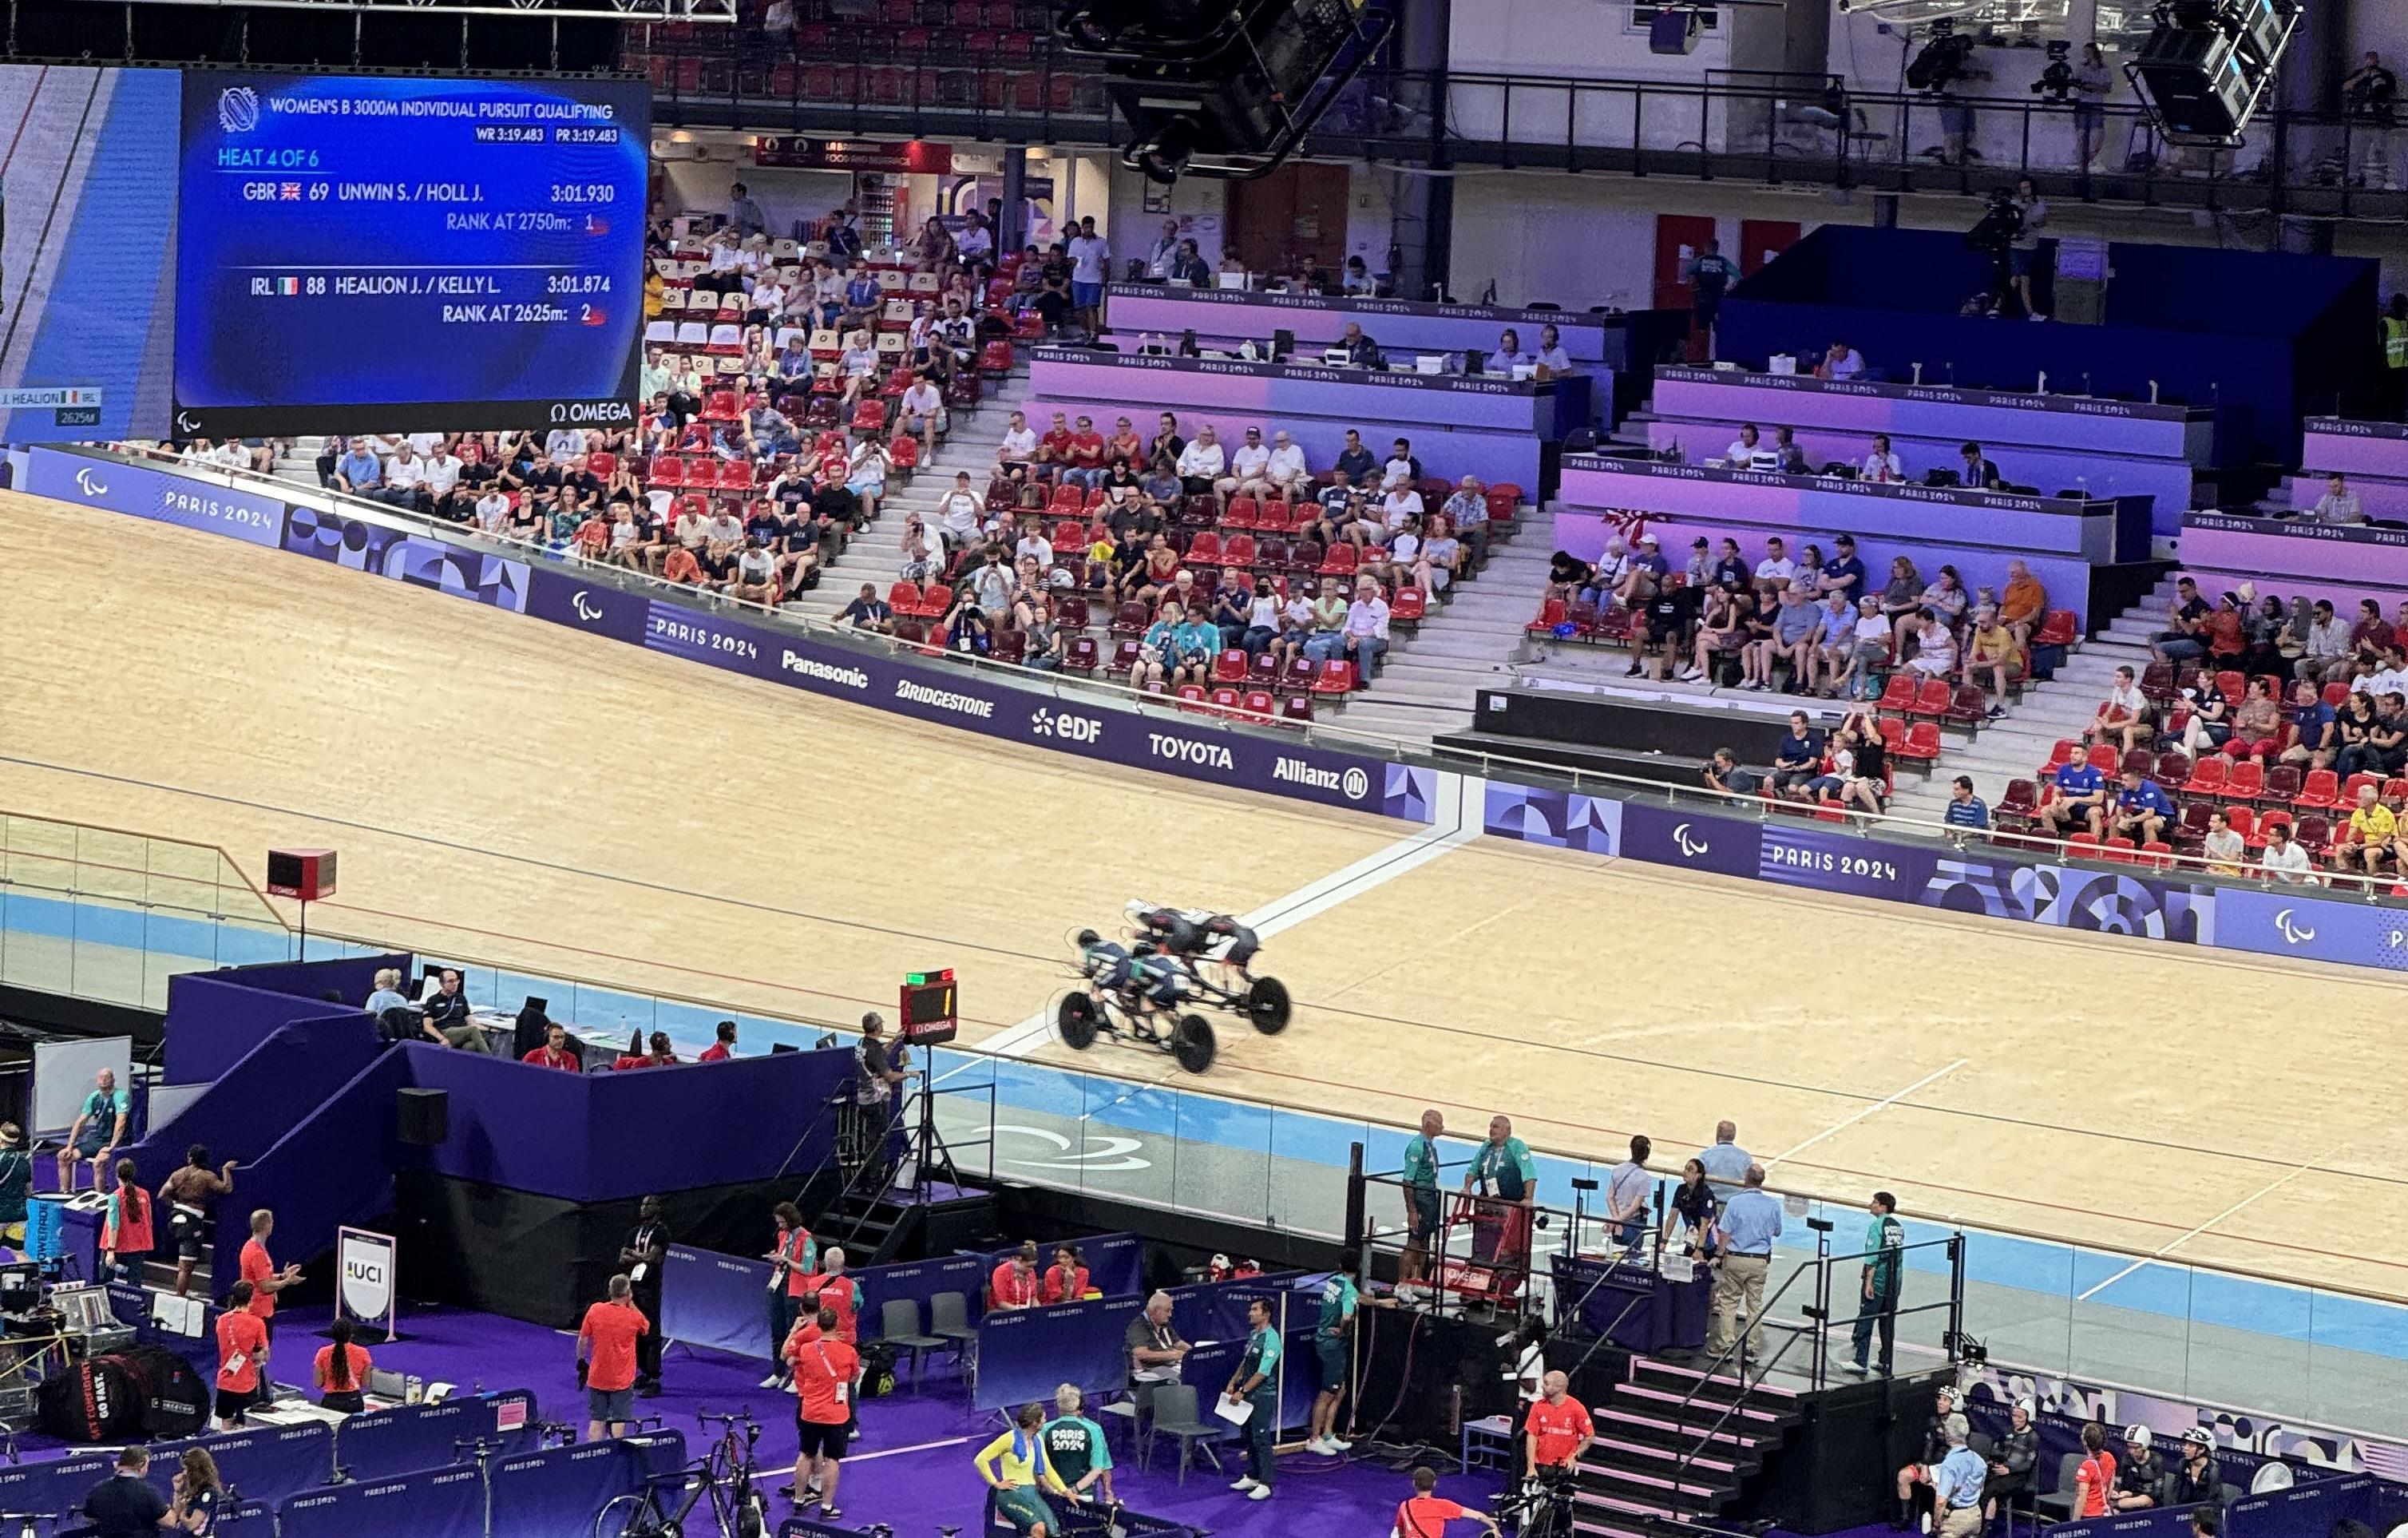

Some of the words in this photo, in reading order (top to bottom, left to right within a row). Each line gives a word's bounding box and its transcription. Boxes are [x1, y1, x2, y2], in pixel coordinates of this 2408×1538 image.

[270, 97, 339, 114] WOMEN'S
[341, 99, 351, 115] B
[353, 100, 398, 116] 3000M
[402, 101, 477, 117] INDIVIDUAL
[479, 102, 532, 118] PURSUIT
[534, 103, 614, 120] QUALIFYING
[476, 128, 495, 141] WR
[497, 128, 544, 141] 3:19.483
[556, 129, 570, 142] PR
[571, 129, 617, 143] 3:19.483
[218, 148, 263, 166] HEAT
[266, 149, 277, 166] 4
[281, 149, 305, 167] OF
[308, 149, 319, 167] 6
[243, 182, 276, 200] GBR
[309, 183, 330, 200] 69
[339, 183, 394, 200] UNWIN
[397, 184, 410, 201] S.
[414, 184, 423, 201] /
[426, 184, 469, 201] HOLL
[471, 184, 484, 202] J.
[551, 184, 614, 203] 3:01.930
[446, 212, 491, 230] RANK
[493, 212, 515, 230] AT
[519, 213, 572, 231] 2750m:
[585, 213, 594, 230] 1
[251, 277, 275, 295] IRL
[306, 276, 326, 295] 88
[335, 276, 407, 295] HEALION
[410, 276, 422, 295] J.
[426, 276, 435, 294] /
[438, 276, 485, 294] KELLY
[488, 276, 501, 294] L.
[547, 275, 611, 294] 3:01.874
[1112, 286, 1138, 295] PARIS
[1140, 287, 1165, 297] 2024
[1192, 291, 1218, 301] PARIS
[1221, 292, 1246, 302] 2024
[1273, 296, 1299, 307] PARIS
[1301, 298, 1329, 308] 2024
[442, 304, 487, 323] RANK
[489, 304, 512, 323] AT
[514, 303, 568, 322] 2625m:
[580, 303, 591, 321] 2
[1356, 302, 1384, 312] PARIS
[1385, 303, 1411, 313] 2024
[1438, 307, 1466, 317] PARIS
[1468, 308, 1494, 318] 2024
[1521, 311, 1550, 322] PARIS
[1551, 313, 1577, 324] 2024
[1037, 351, 1064, 361] PARIS
[1066, 352, 1091, 363] 2024
[1118, 356, 1146, 367] PARIS
[1147, 358, 1172, 368] 2024
[1199, 362, 1227, 372] PARIS
[1229, 363, 1254, 374] 2024
[1285, 368, 1312, 379] PARIS
[1314, 370, 1340, 381] 2024
[1368, 375, 1396, 385] PARIS
[1398, 376, 1424, 386] 2024
[1453, 381, 1481, 391] PARIS
[1483, 382, 1508, 393] 2024
[12, 393, 59, 405] HEALION
[569, 402, 632, 422] OMEGA
[2313, 422, 2342, 432] PARIS
[2344, 423, 2371, 434] 2024
[1570, 458, 1598, 469] PARIS
[1599, 461, 1625, 471] 2024
[1651, 466, 1678, 476] PARIS
[1680, 468, 1705, 479] 2024
[1732, 472, 1759, 483] PARIS
[1761, 474, 1786, 486] 2024
[1816, 480, 1844, 491] PARIS
[1845, 482, 1871, 494] 2024
[1899, 488, 1927, 499] PARIS
[1930, 490, 1955, 501] 2024
[165, 491, 219, 517] PARIS
[224, 505, 273, 529] 2024
[1984, 496, 2013, 507] PARIS
[2014, 498, 2042, 510] 2024
[2195, 517, 2224, 528] PARIS
[2227, 520, 2254, 530] 2024
[2284, 524, 2315, 536] PARIS
[2316, 527, 2344, 538] 2024
[2375, 532, 2406, 544] PARIS
[655, 618, 707, 646] PARIS
[711, 632, 758, 660] 2024
[782, 649, 869, 689] Panasonic
[895, 679, 996, 719] BRIDGESTONE
[1148, 732, 1234, 771] TOYOTA
[1273, 756, 1341, 791] Allianz
[1773, 846, 1833, 871] PARIS
[1840, 856, 1896, 881] 2024
[924, 1021, 952, 1033] OMEGA
[37, 1200, 49, 1262] OWERADE
[354, 1263, 382, 1283] UCI
[97, 1402, 109, 1419] GO
[1052, 1429, 1086, 1441] PARIS
[1053, 1440, 1085, 1451] 2024
